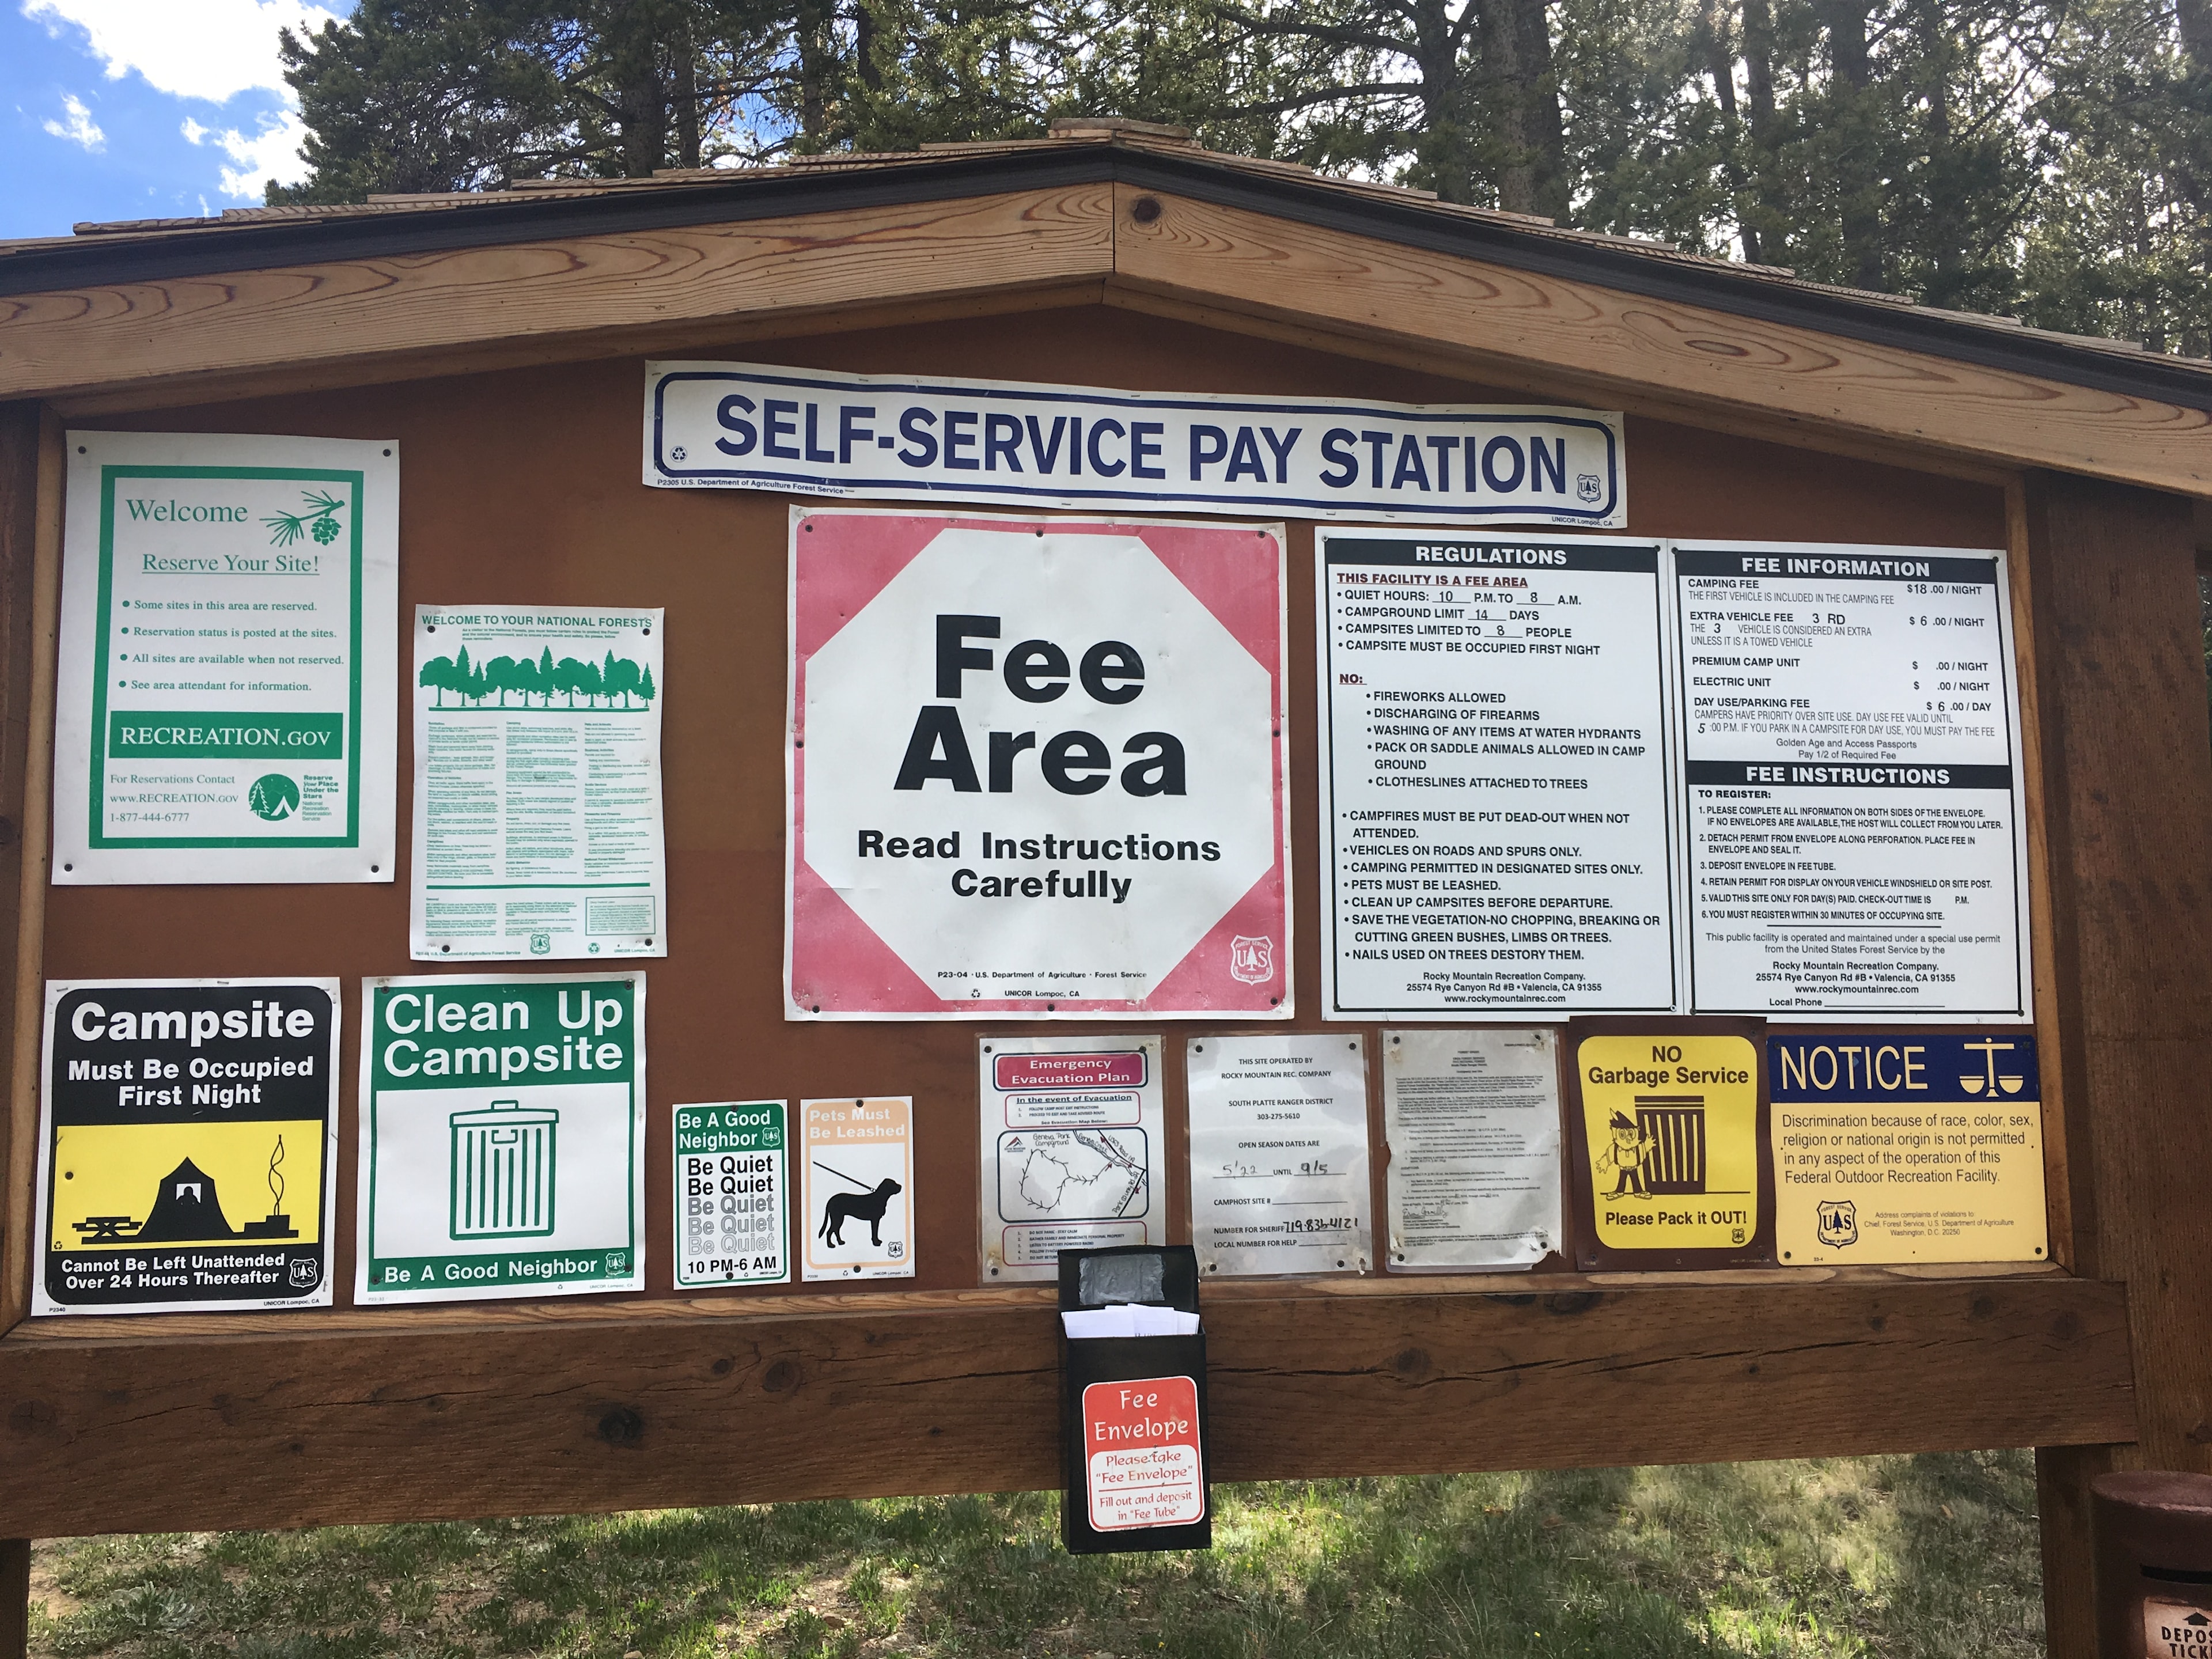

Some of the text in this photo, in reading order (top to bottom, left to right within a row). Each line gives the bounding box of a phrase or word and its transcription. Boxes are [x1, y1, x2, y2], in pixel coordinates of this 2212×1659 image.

[715, 394, 1566, 494] SELF-SERVICE PAY STATION
[125, 499, 248, 522] Welcome
[143, 554, 318, 571] Reserve Your Site!
[1416, 546, 1567, 565] REGULATIONS
[1742, 557, 1930, 577] FEE INFORMATION
[1688, 578, 1759, 589] CAMPING FEE
[134, 600, 163, 609] Some
[166, 600, 190, 609] sites
[193, 601, 203, 609] in
[206, 601, 225, 610] this
[271, 602, 317, 611] reserved.
[422, 615, 652, 628] WELCOME TO YOUR NATIONAL FORESTS
[936, 615, 1145, 704] Fee
[1374, 691, 1506, 703] FIREWORKS ALLOWED
[1374, 708, 1540, 721] DISCHARGING OF FIREARMS
[120, 727, 331, 746] RECREATION.GOV
[893, 706, 1187, 796] Area
[111, 774, 234, 784] For Reservations Contact
[1746, 766, 1950, 785] FEE INSTRUCTIONS
[109, 793, 238, 802] www.RECREATION.GOV
[111, 813, 190, 822] 1-877-444-6777
[859, 830, 1221, 862] Read Instructions
[1700, 861, 1836, 870] 3. DEPOSIT ENVELOPE IN FEE TUBE.
[952, 869, 1131, 904] Carefully
[1423, 972, 1586, 982] Rocky Mountain Recreation Company.
[1444, 994, 1566, 1004] www.rockymountainrec.com
[385, 990, 623, 1036] Clean Up
[71, 1001, 314, 1047] Campsite
[384, 1036, 623, 1081] Campsite
[1652, 1046, 1682, 1063] NO
[69, 1056, 313, 1081] Must Be Occupied
[1030, 1059, 1112, 1070] Emergency
[1781, 1046, 1928, 1090] NOTICE
[1012, 1073, 1130, 1085] Evacuation Plan
[1588, 1066, 1749, 1088] Garbage Service
[119, 1084, 261, 1108] First Night
[679, 1109, 770, 1129] Be A Good
[810, 1108, 890, 1122] Pets Must
[1782, 1113, 2033, 1128] Discrimination because of race, color, sex,
[810, 1124, 905, 1139] Be Leashed
[679, 1131, 757, 1152] Neighbor
[1035, 1139, 1070, 1148] Campground
[688, 1155, 773, 1176] Be Quiet
[688, 1175, 773, 1196] Be Quiet
[688, 1194, 774, 1215] Be Quiet
[688, 1214, 774, 1236] Be Quiet
[1606, 1210, 1747, 1225] Please Pack it OUT!
[688, 1233, 775, 1255] Be Quiet
[385, 1258, 597, 1283] Be A Good Neighbor
[688, 1256, 777, 1274] 10 PM-6 AM
[1119, 1389, 1158, 1410] Fee
[1094, 1416, 1189, 1441] Envelope
[1106, 1450, 1181, 1466] Please take
[1096, 1465, 1193, 1483] "Fee Envelope"
[1100, 1490, 1192, 1508] Fill out and deposit
[1118, 1505, 1180, 1521] in "Fee Tube"
[2169, 1643, 2212, 1659] TICK
